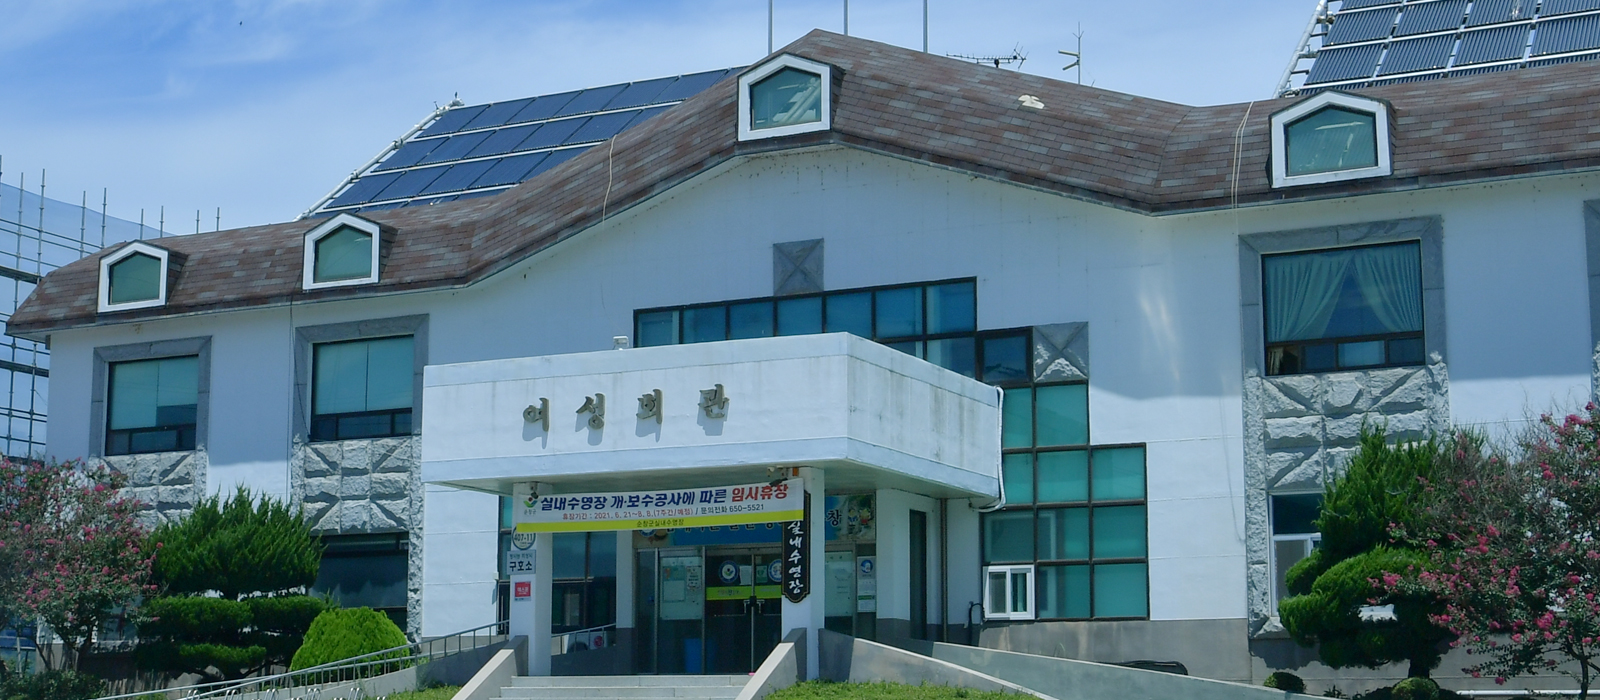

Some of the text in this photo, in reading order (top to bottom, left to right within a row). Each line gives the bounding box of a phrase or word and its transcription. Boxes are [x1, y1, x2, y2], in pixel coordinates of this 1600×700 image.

[541, 496, 608, 511] 실내수영장
[700, 489, 727, 504] 따른
[731, 484, 789, 502] 임시휴장
[701, 506, 727, 515] 문의전화
[729, 504, 764, 513] 650-5521
[637, 519, 684, 528] 순창군실내수영장
[788, 521, 804, 594] 실내수영장
[509, 561, 532, 572] 구호소
